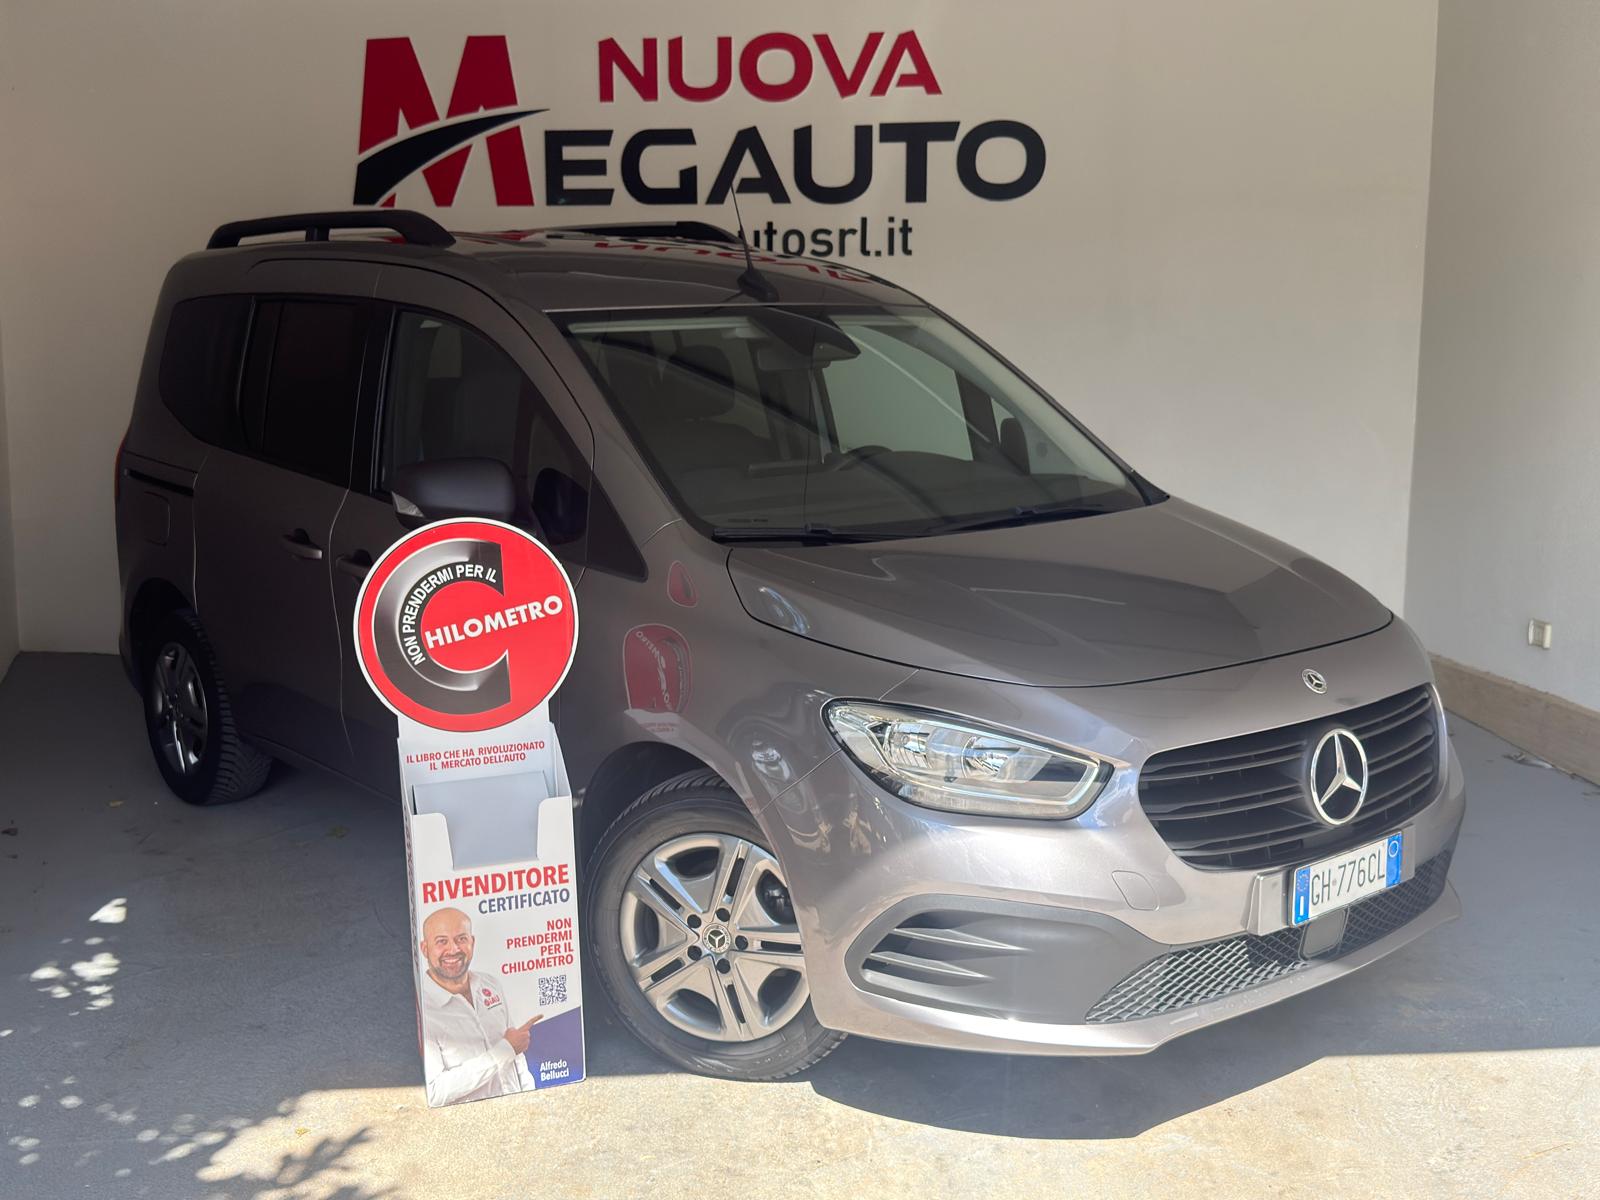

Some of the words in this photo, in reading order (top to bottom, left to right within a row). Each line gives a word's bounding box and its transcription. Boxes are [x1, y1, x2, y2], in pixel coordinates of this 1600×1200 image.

[598, 29, 943, 103] NUOVA
[455, 564, 484, 578] PER
[485, 567, 497, 583] IL
[402, 566, 454, 634] PRENDERMI
[403, 635, 426, 666] NON
[406, 754, 415, 764] IL
[416, 751, 442, 763] LIBRO
[443, 749, 461, 760] CHE
[462, 748, 475, 758] HA
[478, 740, 545, 756] RIVOLUZIONATO
[429, 761, 438, 771] IL
[441, 756, 481, 770] MERCATO
[422, 863, 569, 904] RIVENDITORE
[478, 888, 570, 915] CERTIFICATO
[546, 917, 572, 931] NON
[506, 930, 573, 949] PRENDERMI
[540, 943, 561, 956] PER
[563, 942, 574, 953] IL
[501, 953, 574, 974] CHILOMETRO
[540, 1059, 567, 1071] Alfredo
[540, 1067, 569, 1081] Bellucci
